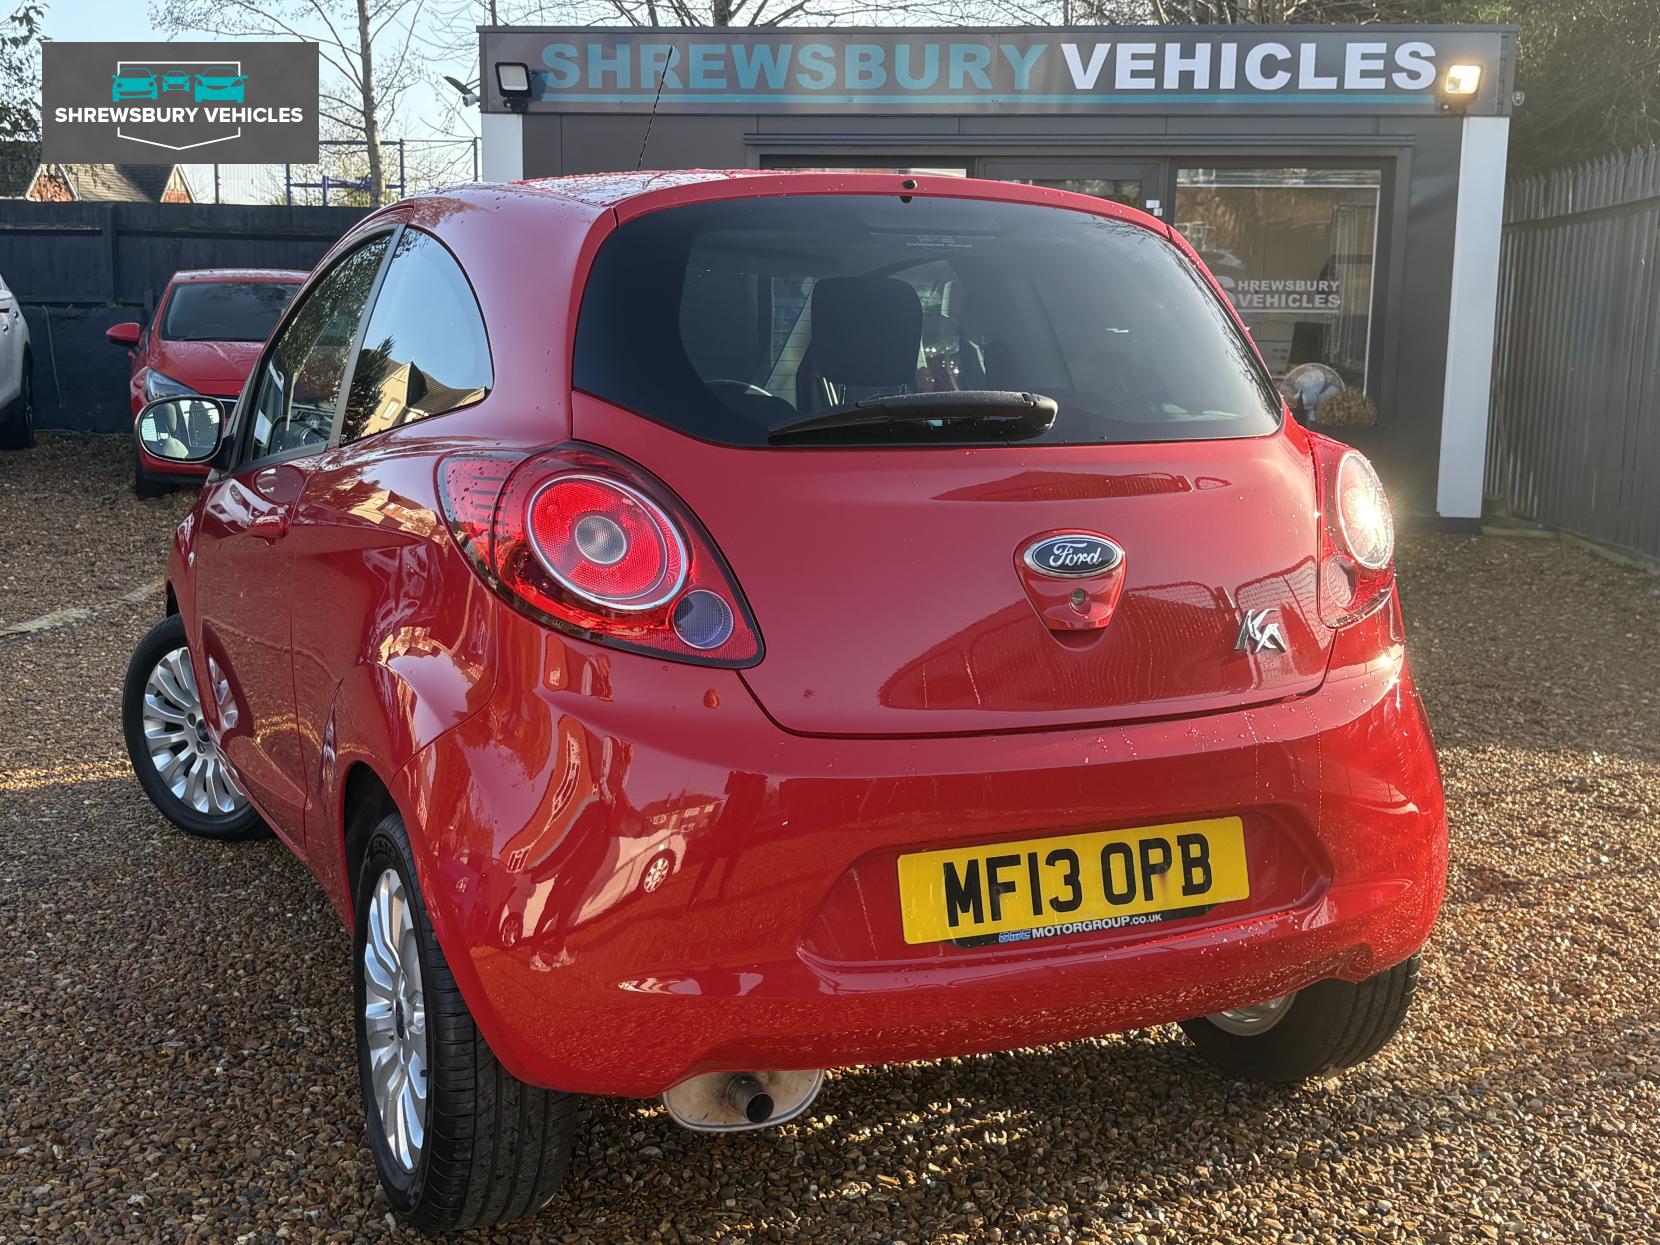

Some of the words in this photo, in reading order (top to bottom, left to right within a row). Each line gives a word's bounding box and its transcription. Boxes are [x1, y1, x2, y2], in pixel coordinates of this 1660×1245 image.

[541, 43, 1047, 90] SHREWSBURY
[1061, 41, 1437, 90] VEHICLES
[1238, 294, 1341, 308] VEHICLES
[1050, 542, 1102, 567] Ford
[943, 848, 1083, 927] MF13
[1100, 832, 1213, 906] OPB
